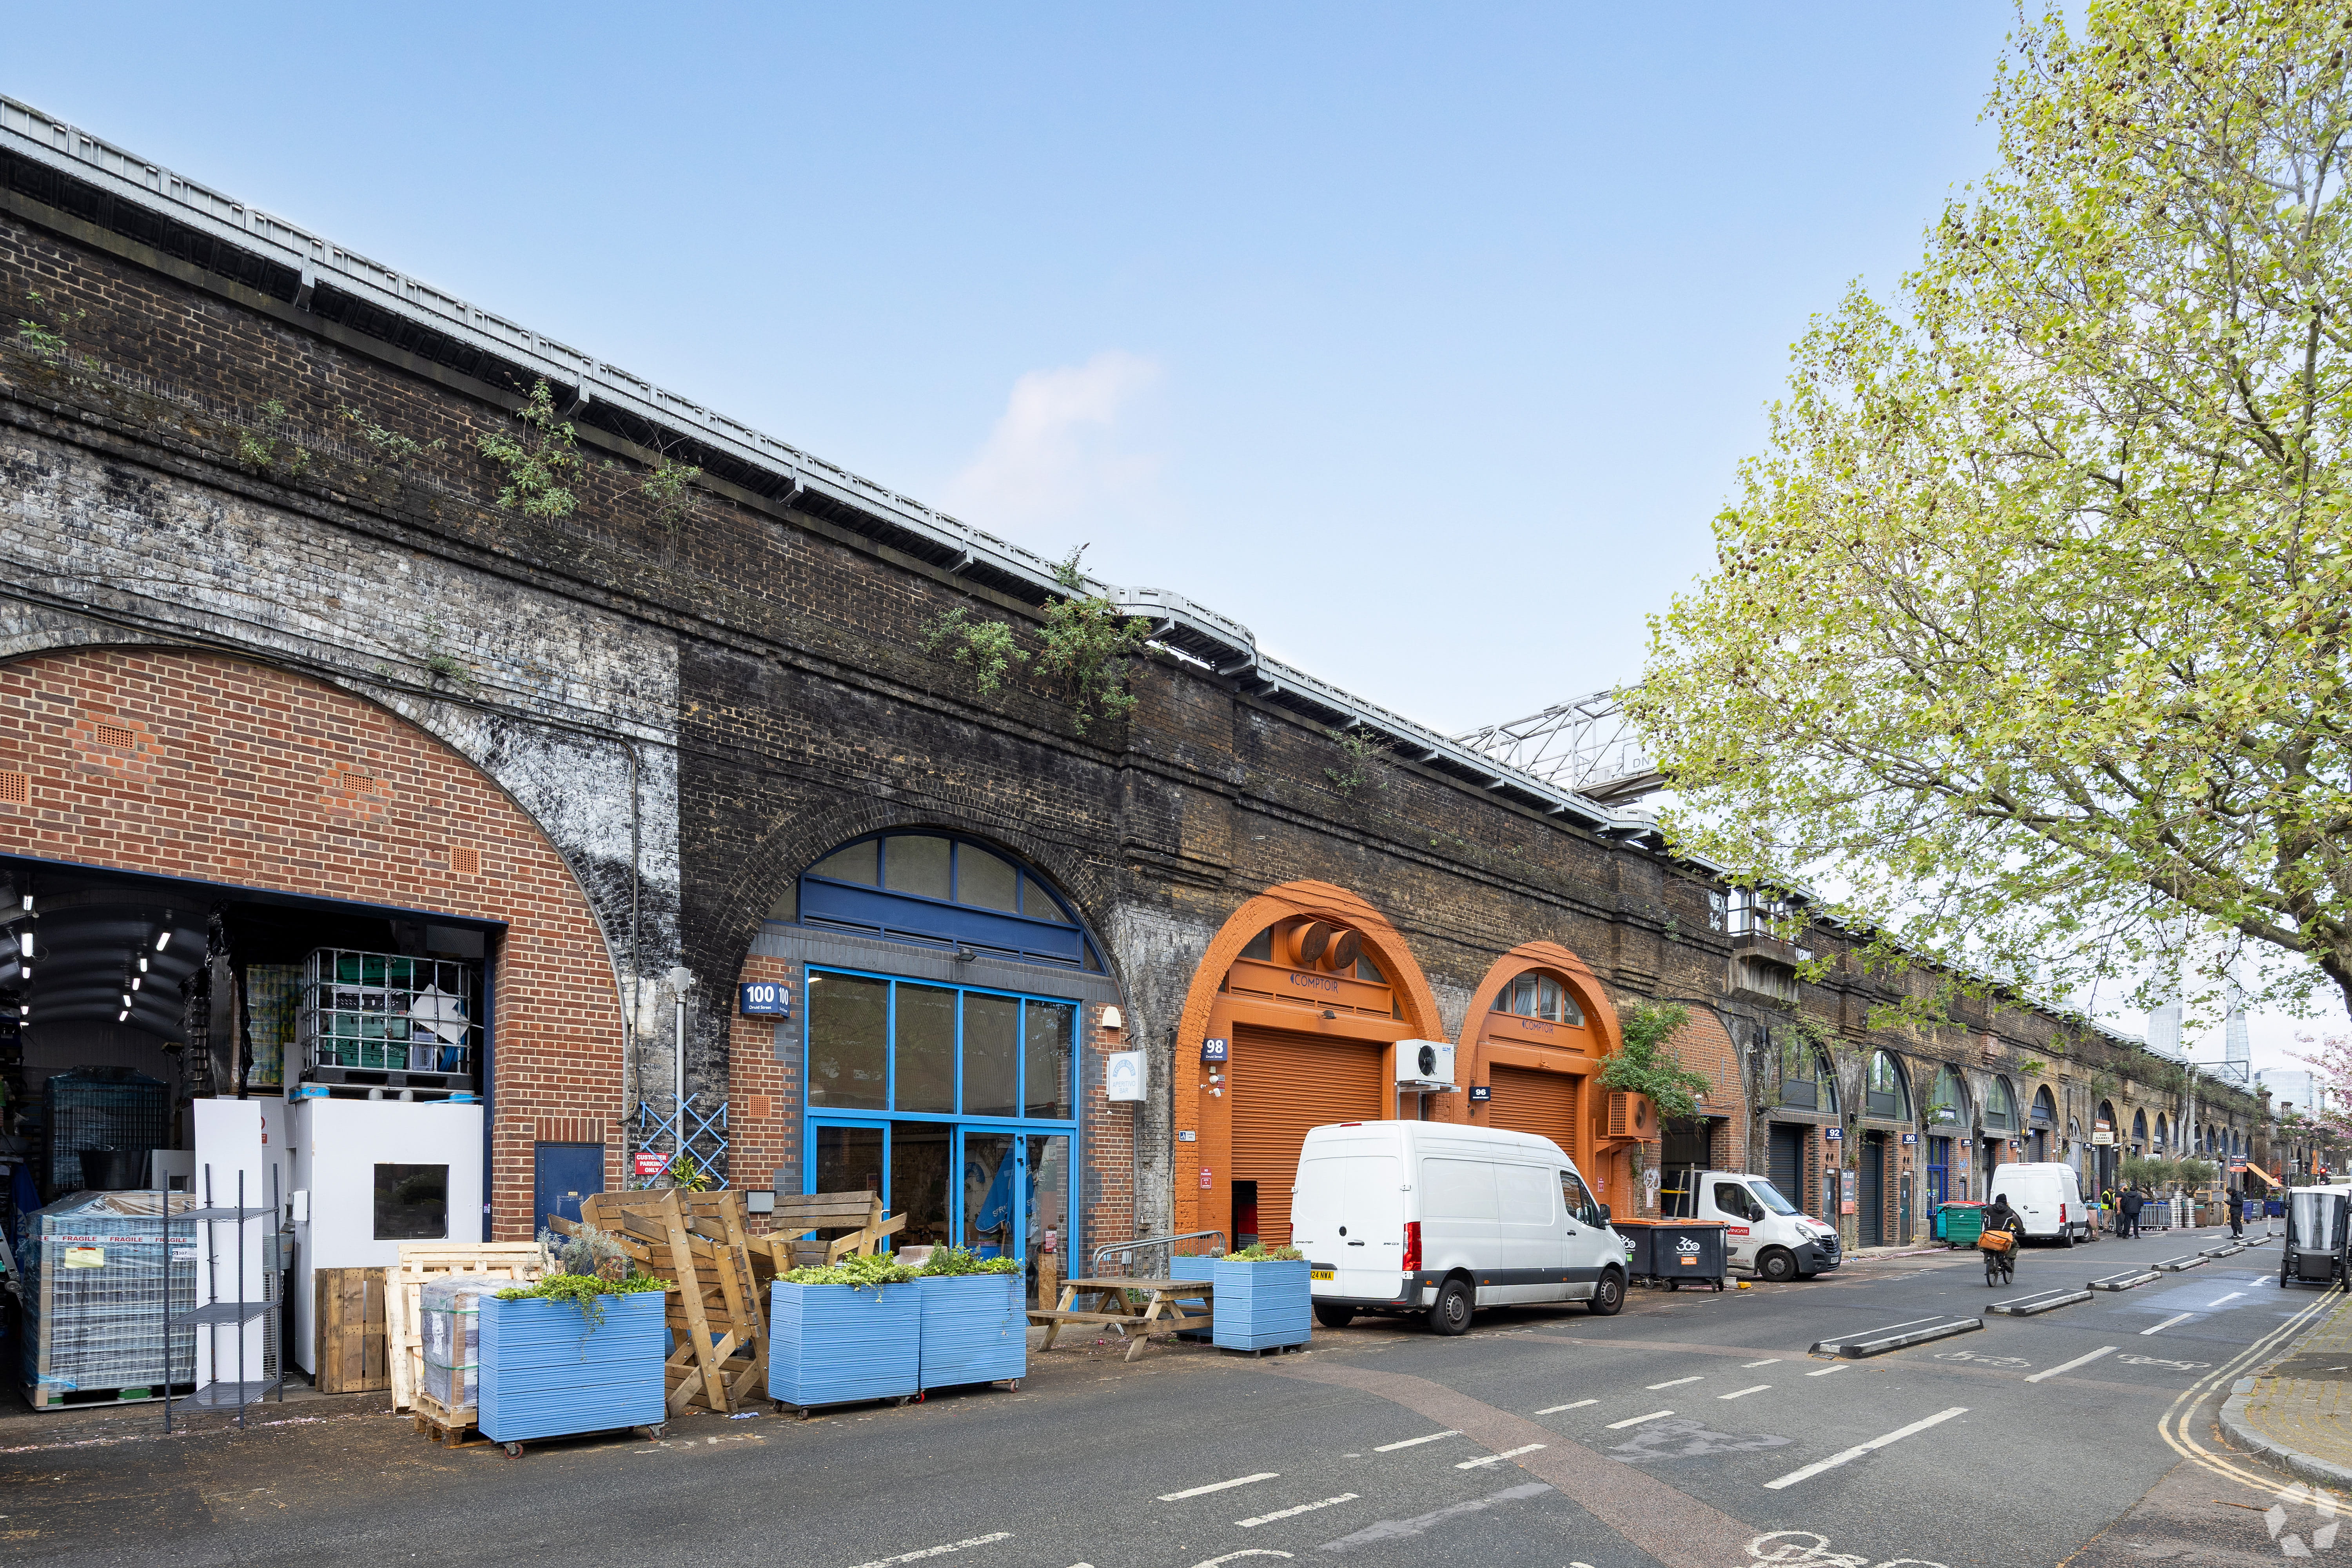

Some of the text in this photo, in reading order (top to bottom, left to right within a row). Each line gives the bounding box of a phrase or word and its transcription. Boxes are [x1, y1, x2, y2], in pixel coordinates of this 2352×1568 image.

[1295, 974, 1338, 994] COMPTOIR
[746, 985, 774, 1002] 100
[779, 987, 788, 1005] 100
[1525, 1020, 1553, 1035] COMPTOIR
[1207, 1040, 1223, 1053] 98
[1113, 1060, 1135, 1075] THESE DAYS
[993, 1202, 1007, 1217] SPRI
[17, 1214, 26, 1233] AYS
[1676, 1236, 1700, 1251] 360
